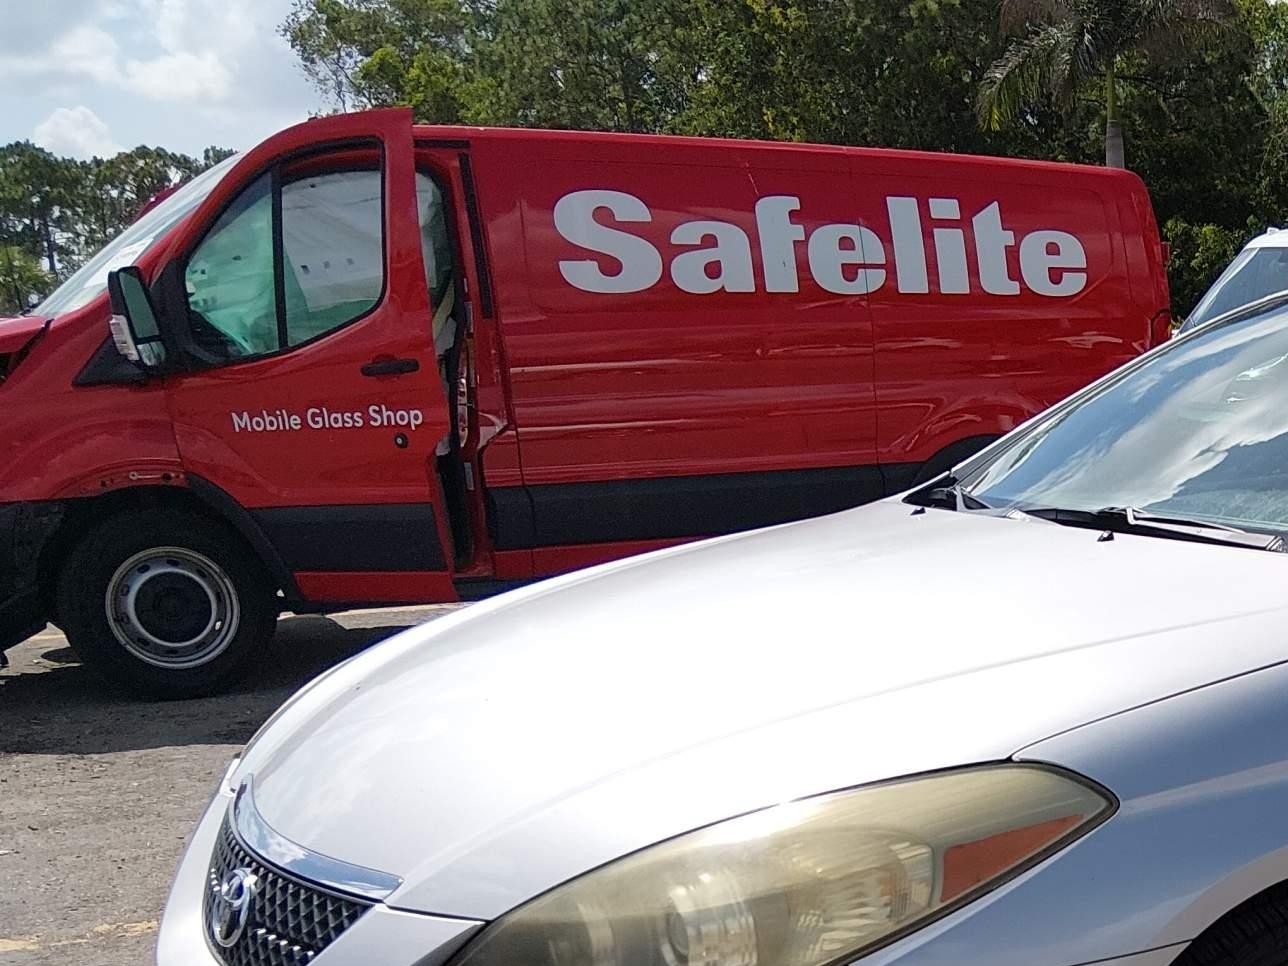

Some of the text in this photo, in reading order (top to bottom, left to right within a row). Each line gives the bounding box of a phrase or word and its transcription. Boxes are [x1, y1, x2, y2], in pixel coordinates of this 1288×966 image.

[553, 189, 1087, 297] Safelite
[231, 403, 423, 433] Mobile Glass Shop
